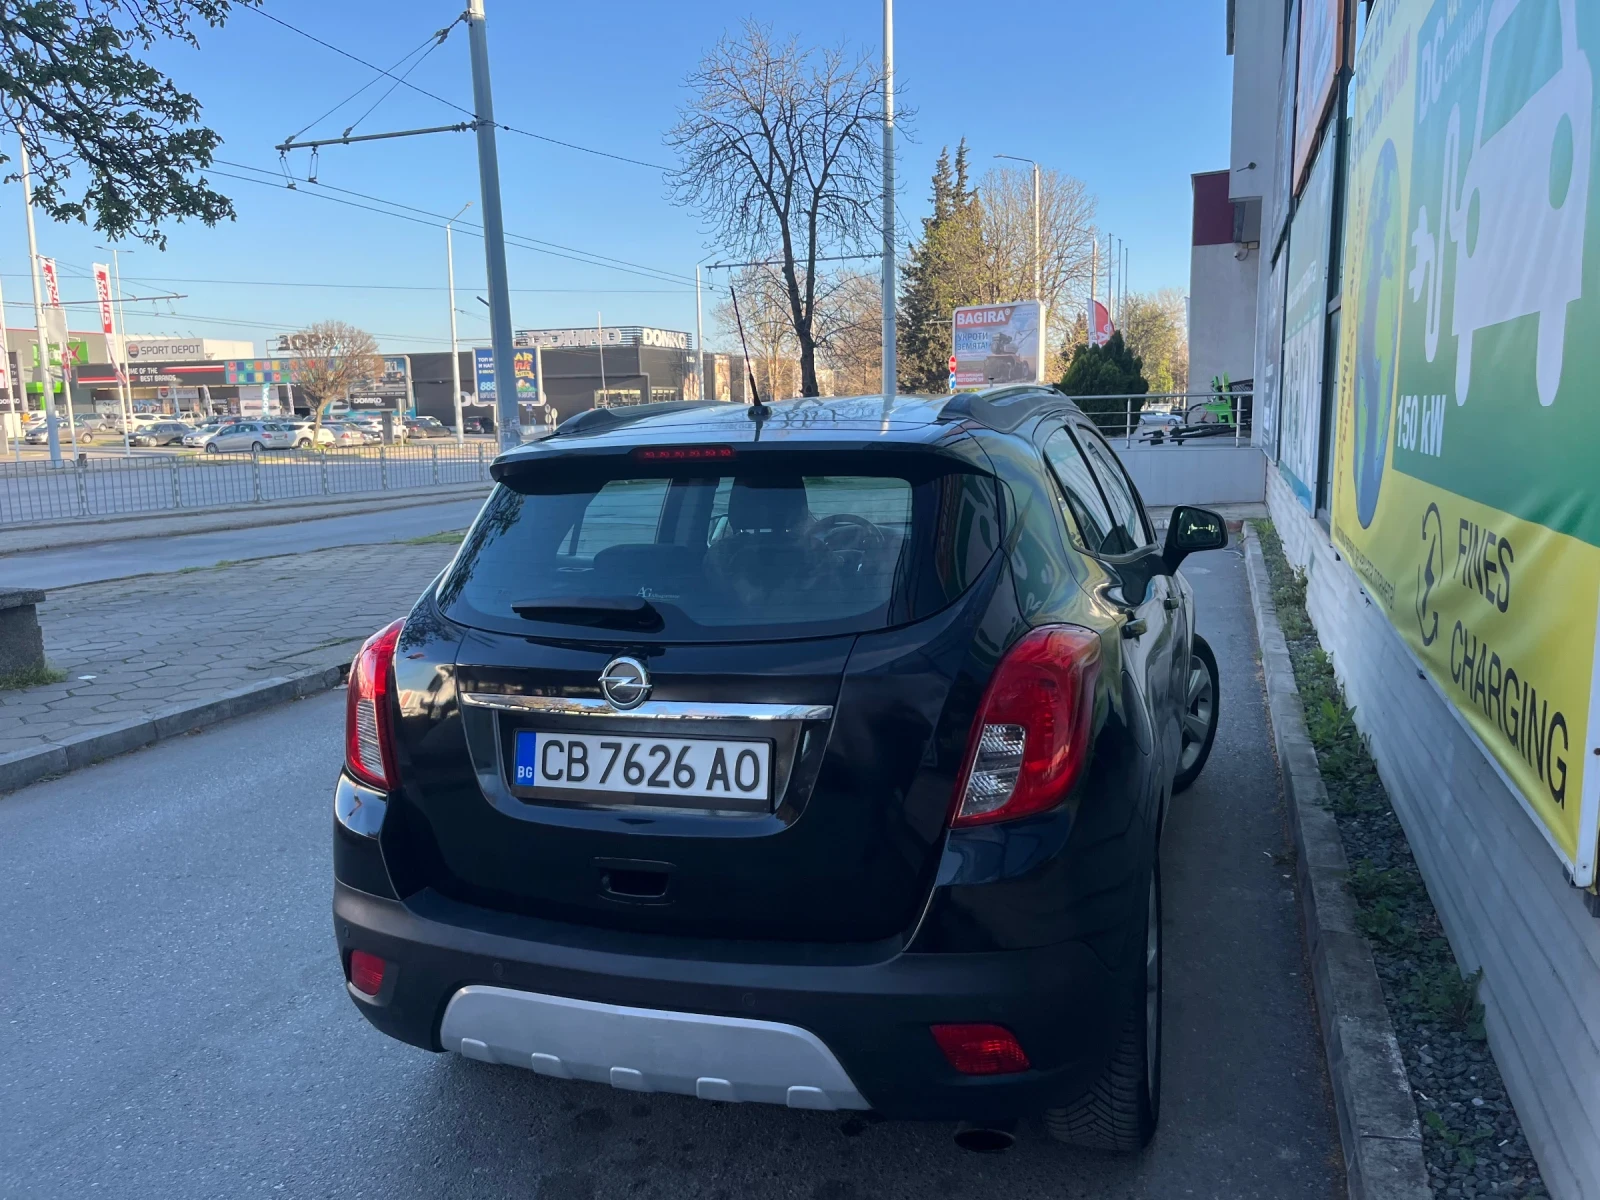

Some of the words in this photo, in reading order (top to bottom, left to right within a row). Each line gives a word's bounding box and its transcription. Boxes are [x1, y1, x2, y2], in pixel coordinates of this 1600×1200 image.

[1419, 16, 1444, 125] DC
[527, 328, 621, 347] DOMKO
[643, 328, 687, 349] DOMKO
[957, 332, 988, 341] УКРОТИ
[957, 342, 988, 351] ЗЕМЯТА!
[141, 346, 168, 355] SPORT
[172, 345, 200, 354] DEPOT
[1397, 394, 1418, 451] 150
[1420, 394, 1447, 457] kW
[1453, 517, 1514, 613] FINES
[1450, 619, 1569, 811] CHARGING
[517, 765, 533, 779] BG
[541, 739, 589, 783] CB
[599, 742, 696, 789] 7626
